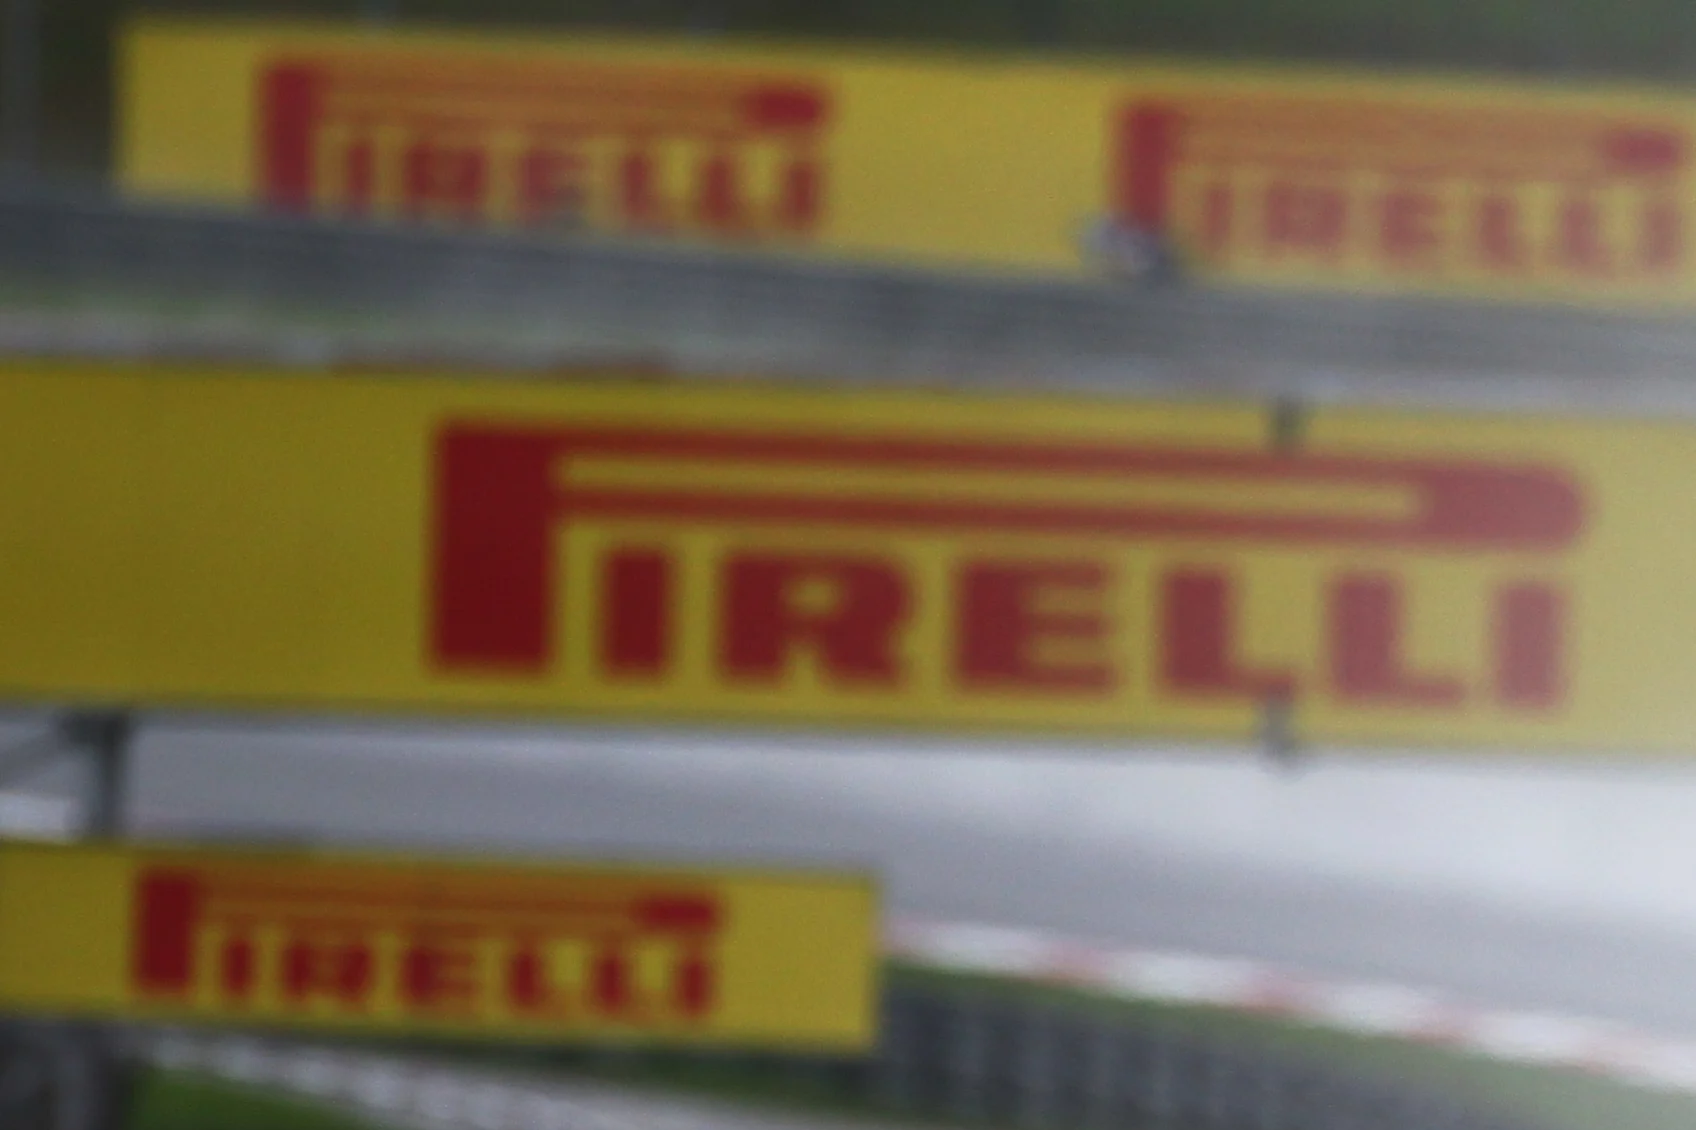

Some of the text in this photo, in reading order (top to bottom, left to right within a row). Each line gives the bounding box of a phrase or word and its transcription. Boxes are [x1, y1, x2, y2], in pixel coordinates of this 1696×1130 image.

[258, 53, 828, 240] PIRELLI
[1112, 94, 1687, 275] PIRELLI
[430, 420, 1587, 712] PIRELLI
[131, 864, 720, 1024] PIRELLI
